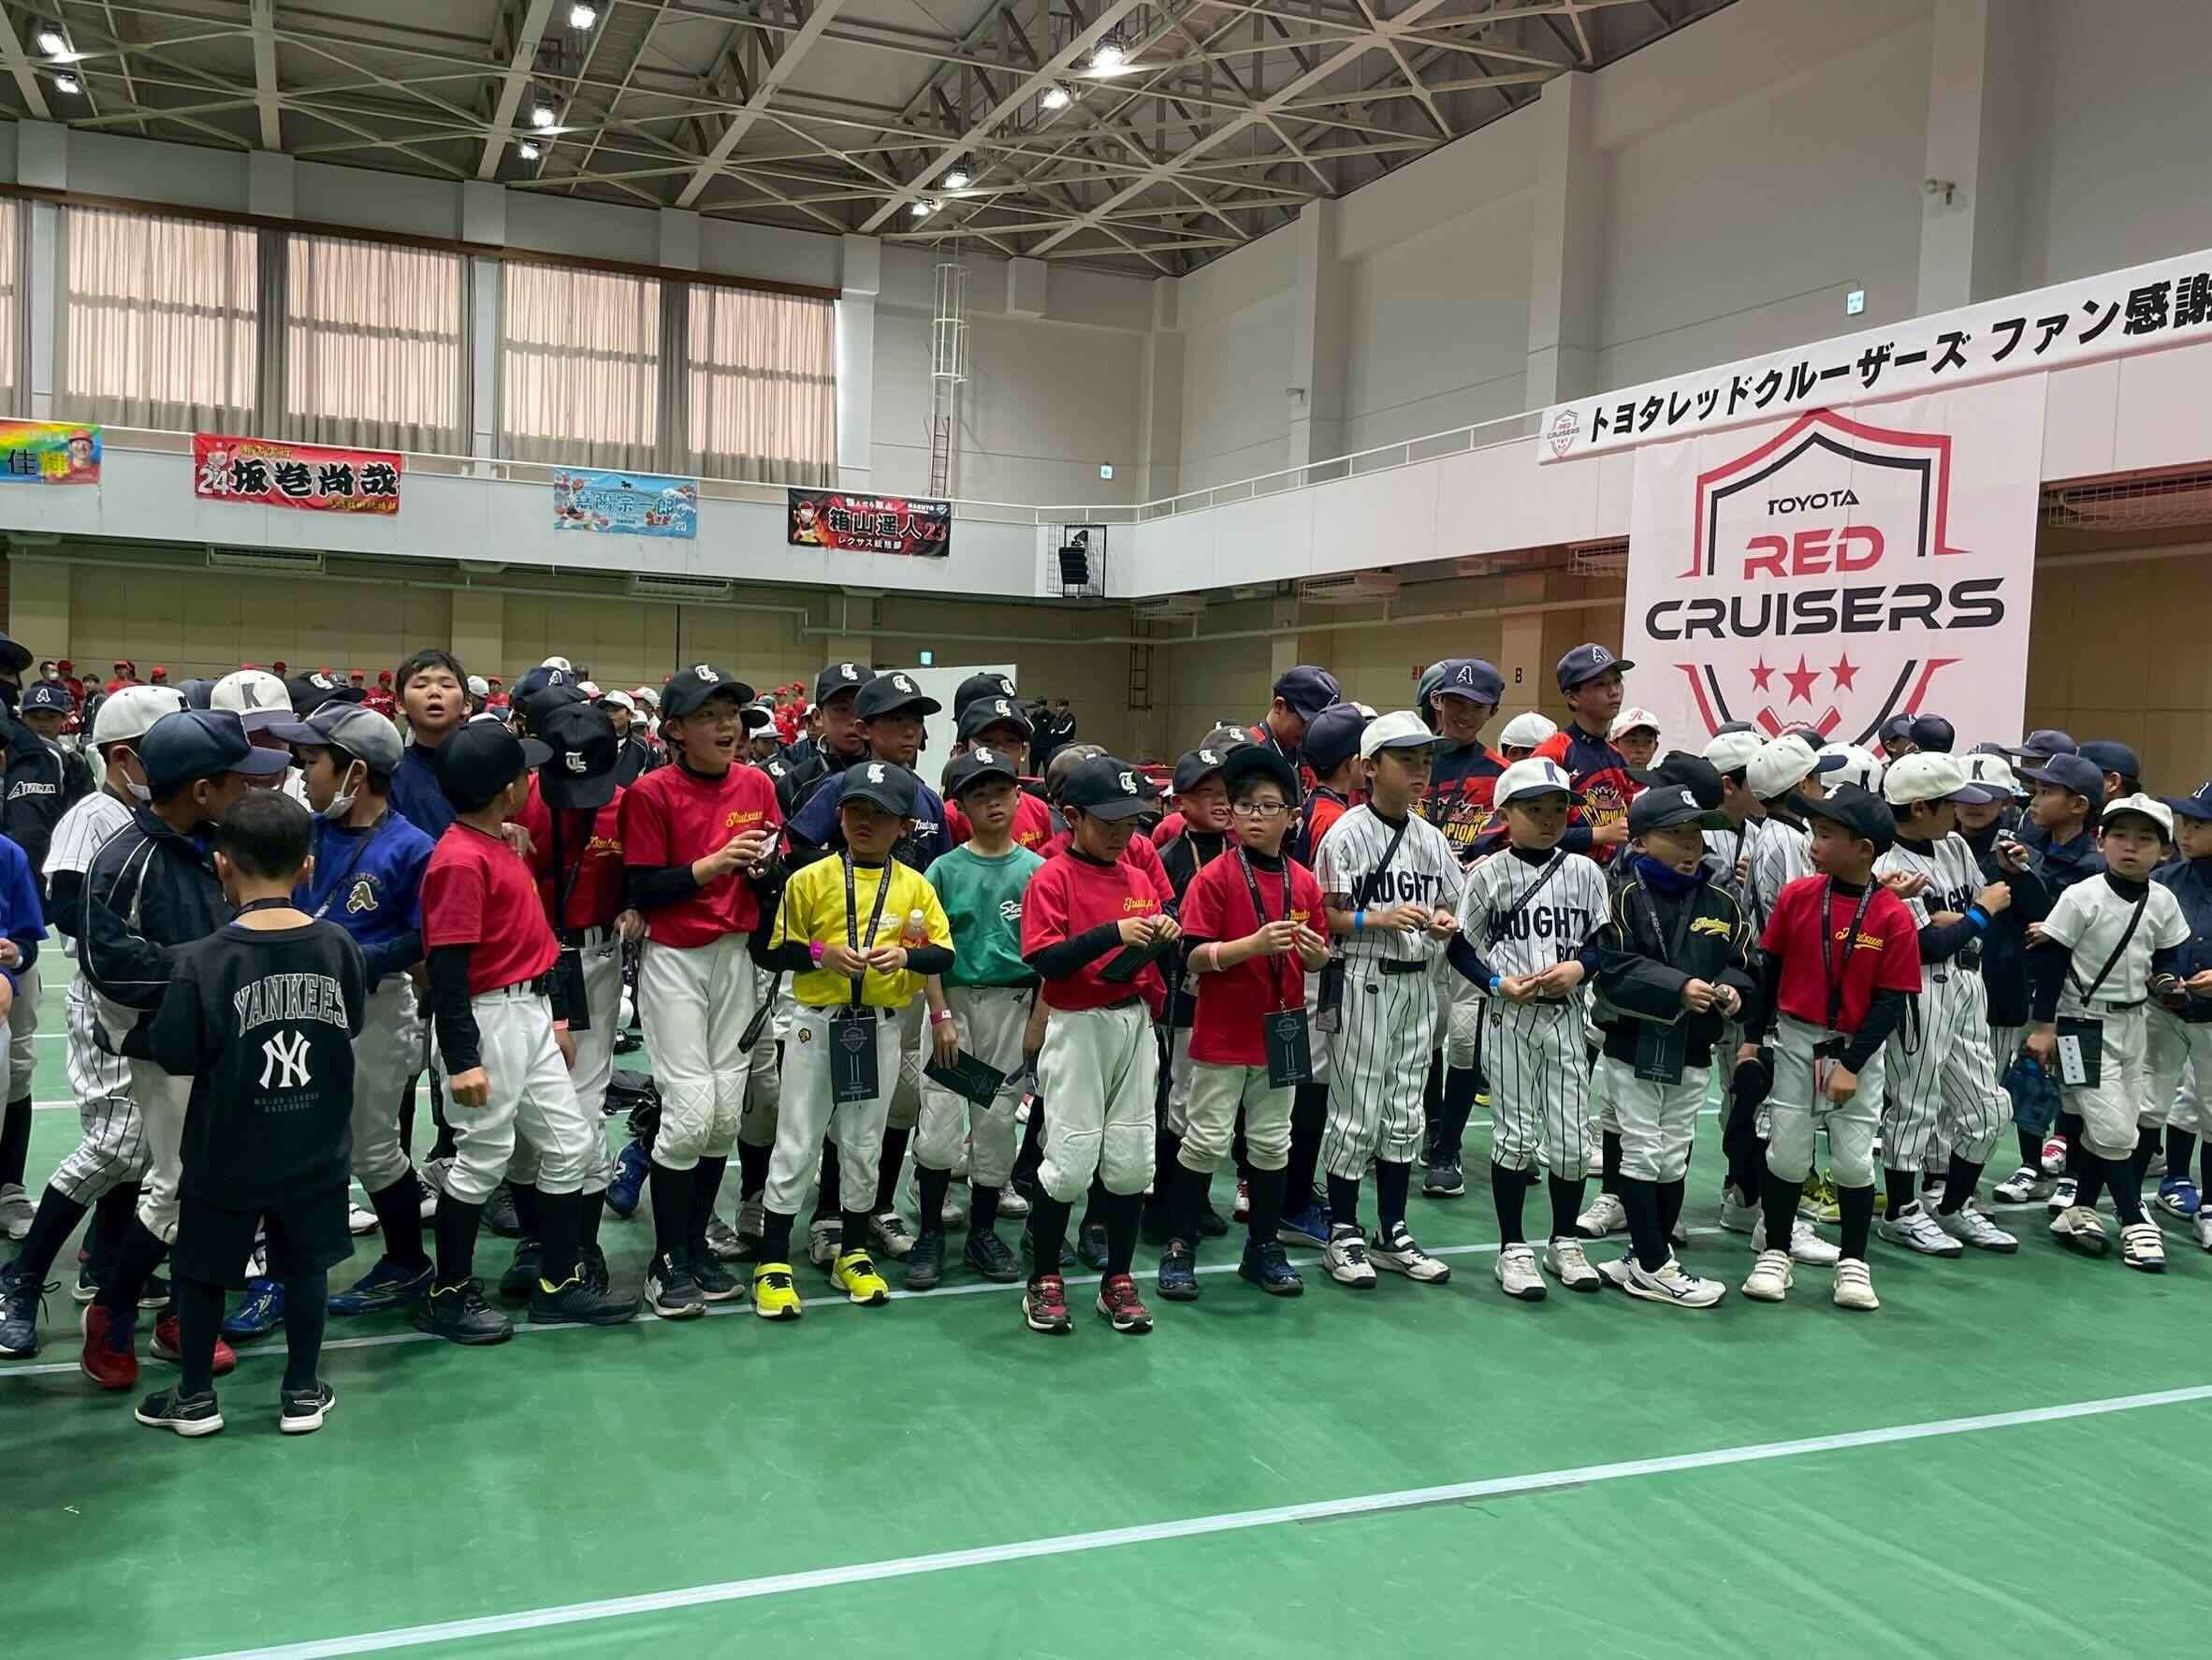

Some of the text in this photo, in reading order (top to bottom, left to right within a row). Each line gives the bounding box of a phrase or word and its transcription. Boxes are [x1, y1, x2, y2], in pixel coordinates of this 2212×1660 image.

[1591, 329, 1971, 443] トヨタレッドクルーザーズ
[198, 469, 228, 495] 24
[1768, 488, 1860, 516] TOYOTA
[1743, 524, 1885, 581] RED
[1644, 576, 2005, 641] CRUISERS
[240, 683, 262, 708] K
[1972, 759, 1985, 780] K
[234, 972, 351, 1038] YANKEES
